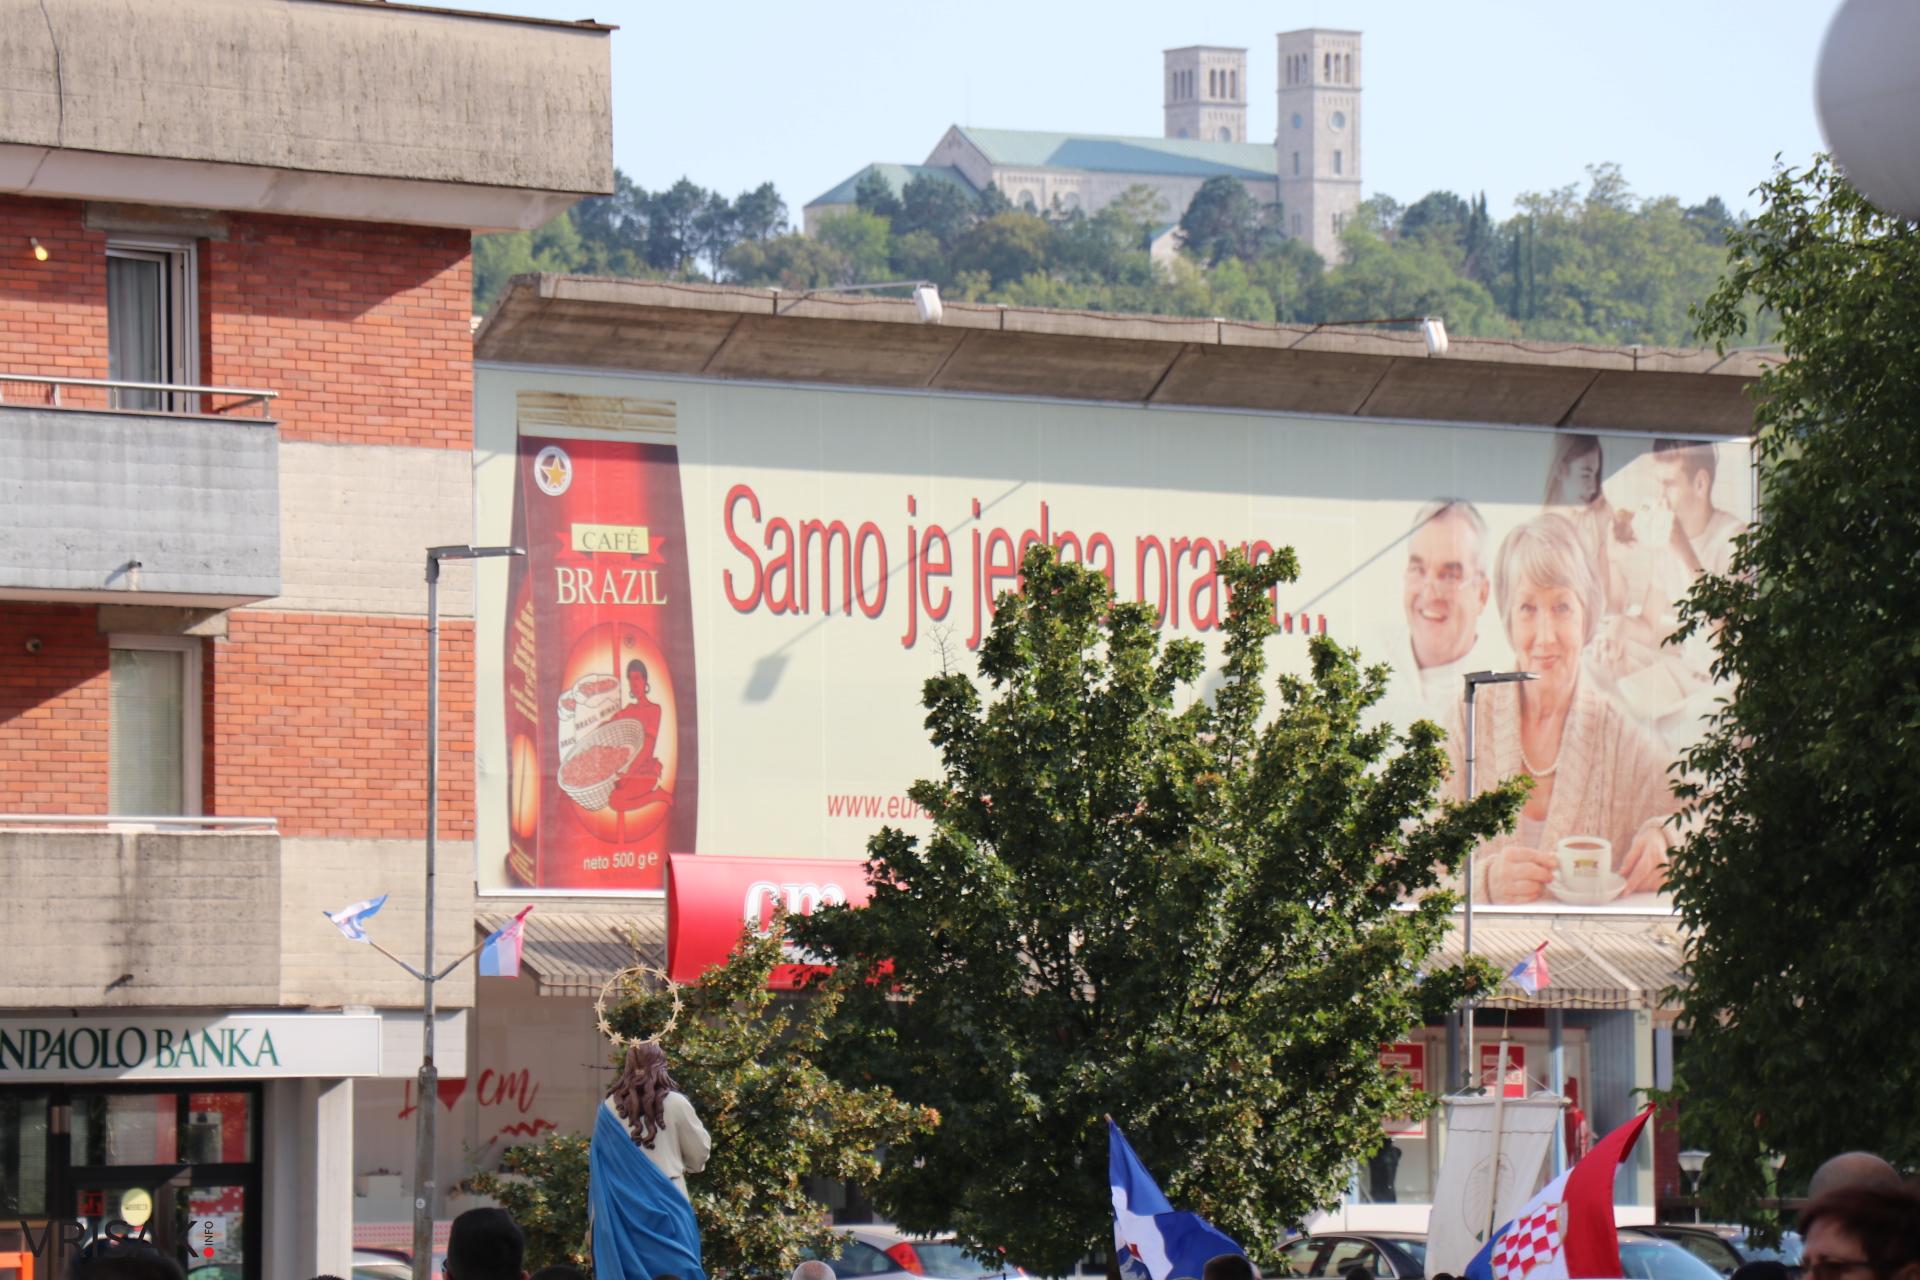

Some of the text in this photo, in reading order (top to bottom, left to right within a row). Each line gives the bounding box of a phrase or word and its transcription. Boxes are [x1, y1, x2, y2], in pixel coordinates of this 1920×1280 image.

[581, 528, 640, 551] CAFÉ
[554, 565, 668, 606] BRAZIL
[723, 483, 888, 619] Samo
[901, 494, 953, 648] je
[583, 856, 610, 870] neto
[612, 851, 634, 869] 500
[0, 1026, 281, 1070] NPAOLO BANKA
